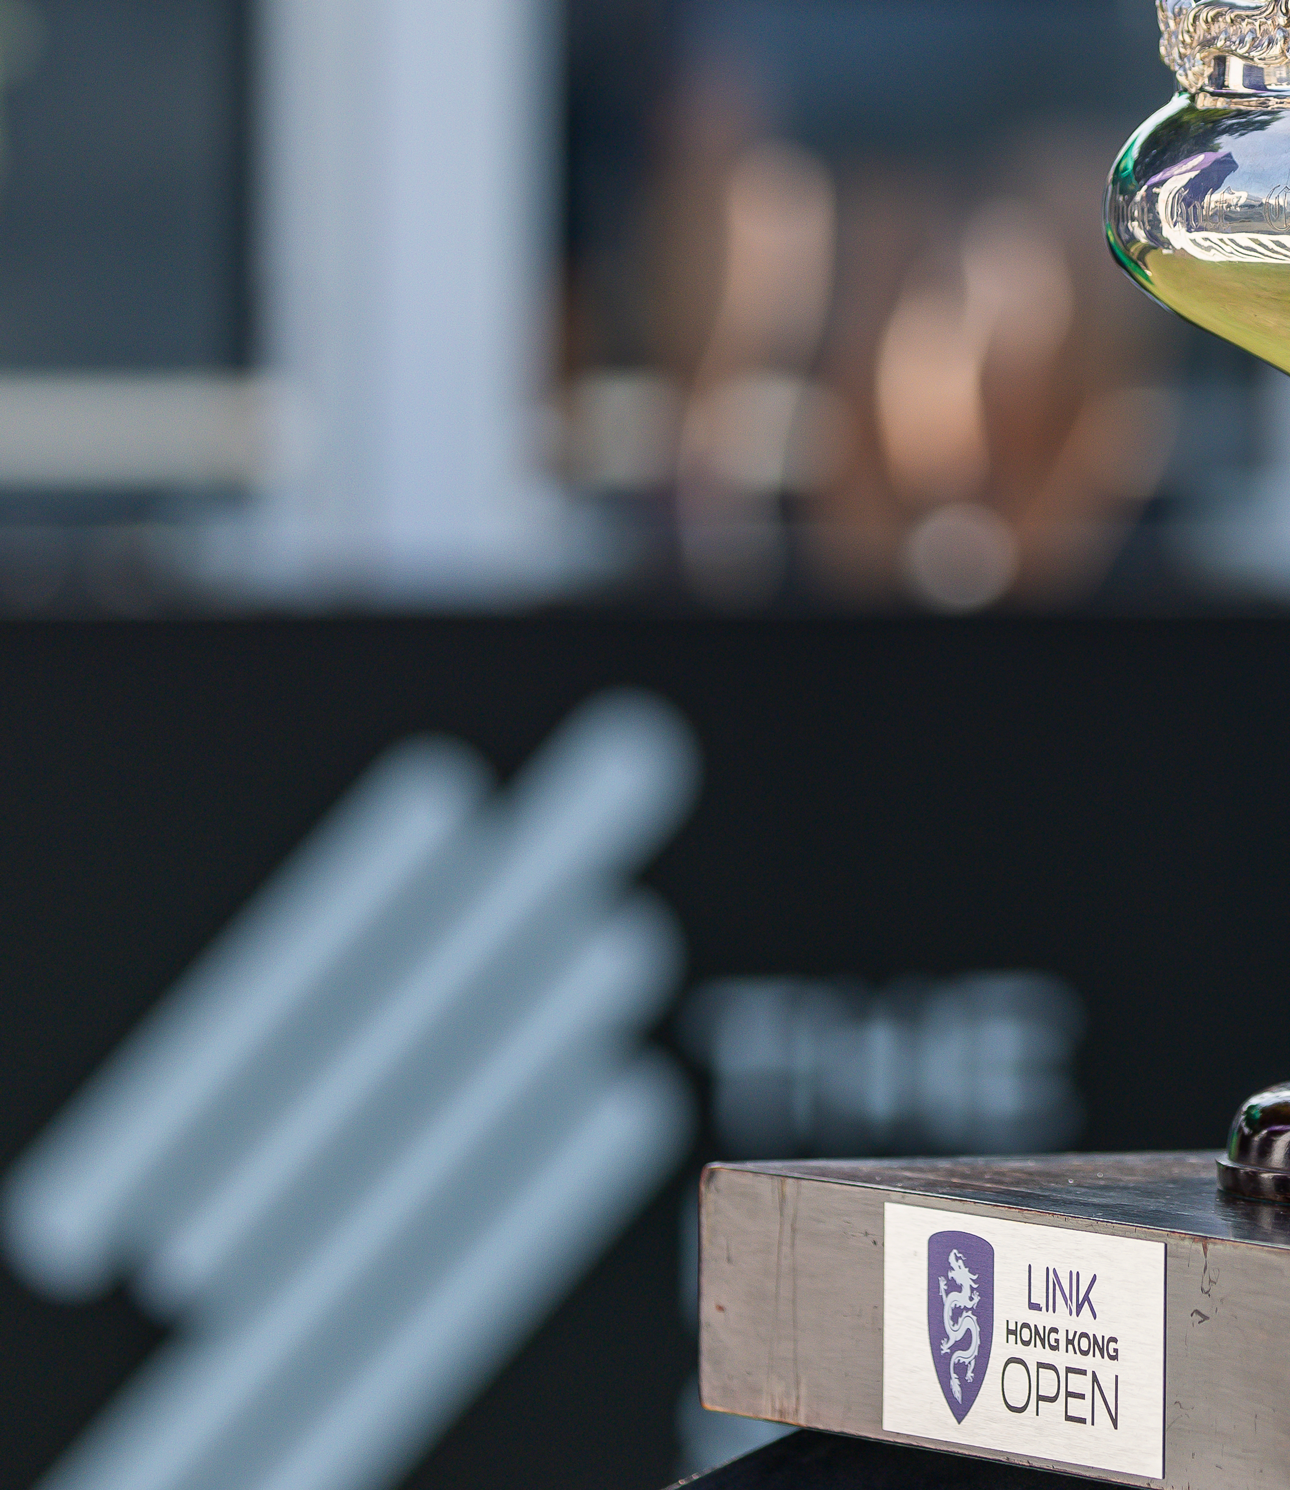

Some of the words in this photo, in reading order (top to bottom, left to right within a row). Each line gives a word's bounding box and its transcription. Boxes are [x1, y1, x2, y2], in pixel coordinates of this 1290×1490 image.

[1027, 1263, 1098, 1321] LINK
[1005, 1319, 1060, 1352] HONG
[1065, 1328, 1120, 1363] KONG
[1001, 1356, 1120, 1432] OPEN
